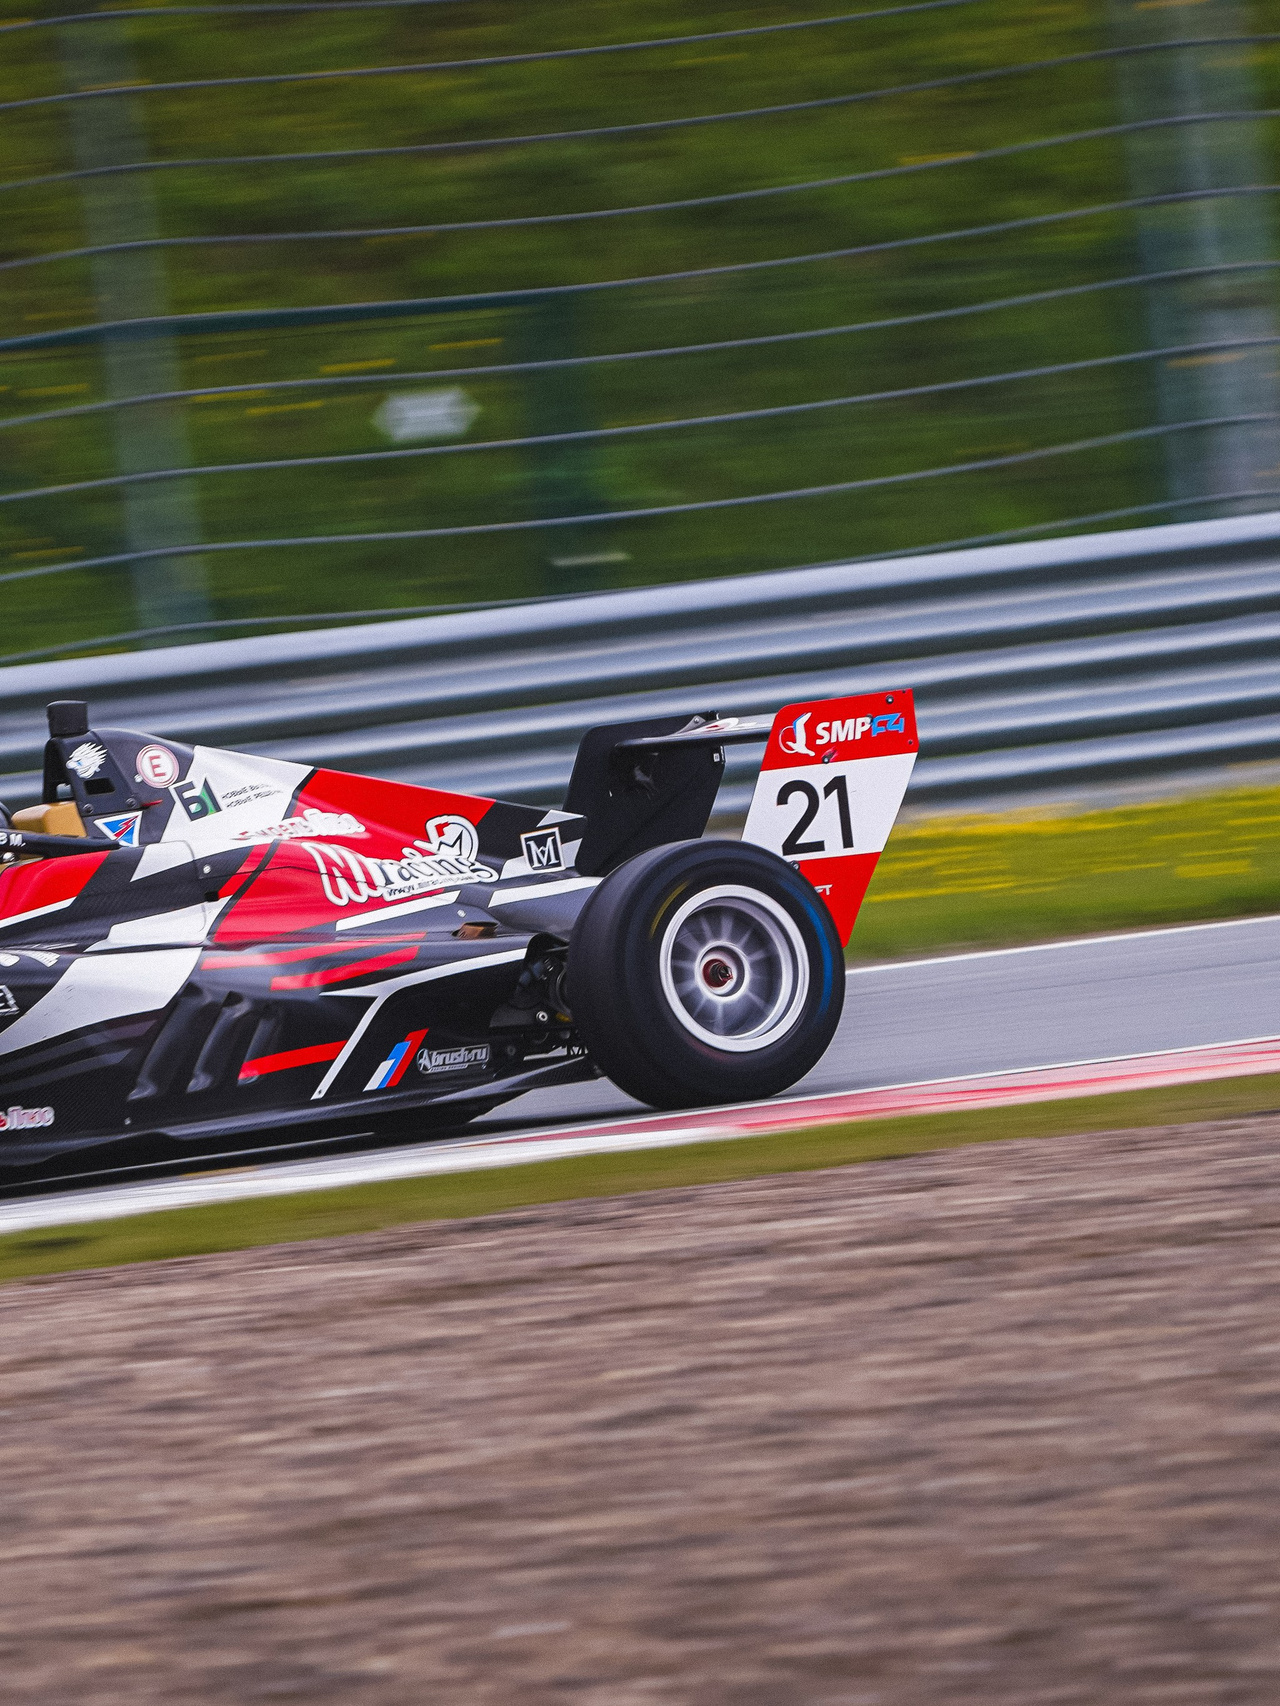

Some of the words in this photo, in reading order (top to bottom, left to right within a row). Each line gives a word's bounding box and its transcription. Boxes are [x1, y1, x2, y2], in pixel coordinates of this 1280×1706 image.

[148, 754, 166, 777] E
[776, 775, 854, 856] 21
[814, 884, 833, 896] FT
